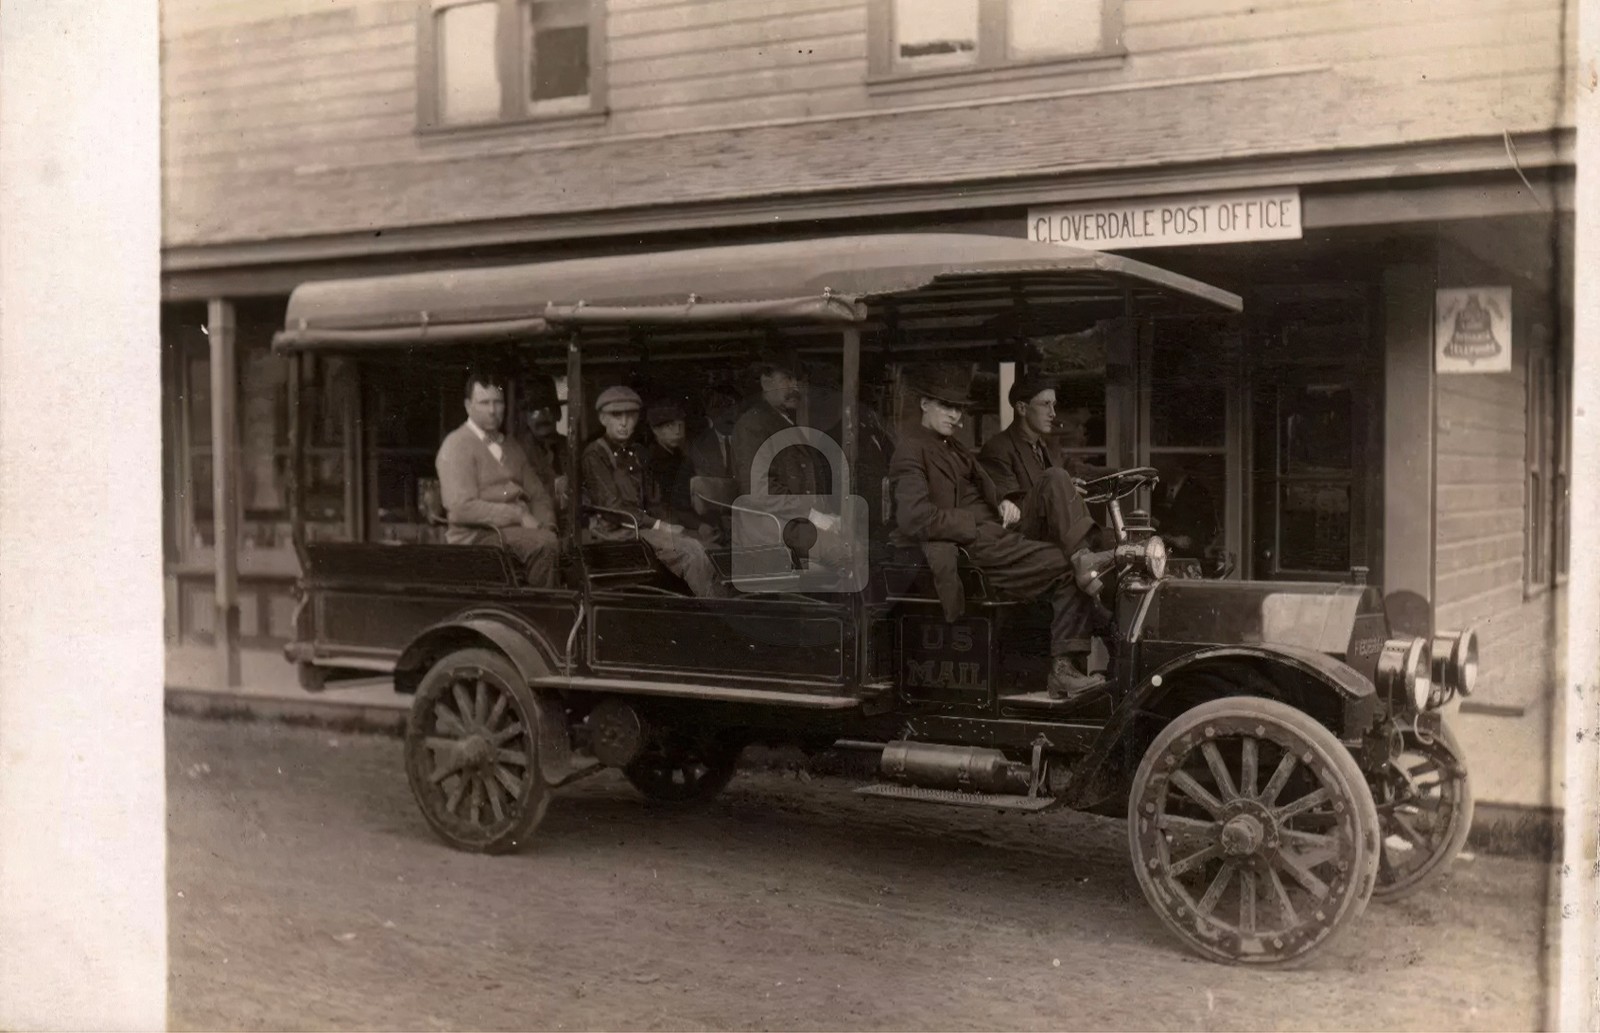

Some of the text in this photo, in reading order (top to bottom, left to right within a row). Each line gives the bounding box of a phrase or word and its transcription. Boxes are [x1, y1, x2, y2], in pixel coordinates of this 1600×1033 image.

[1034, 200, 1293, 244] CLOVERDALE POST OFFICE
[906, 660, 988, 690] MAIL
